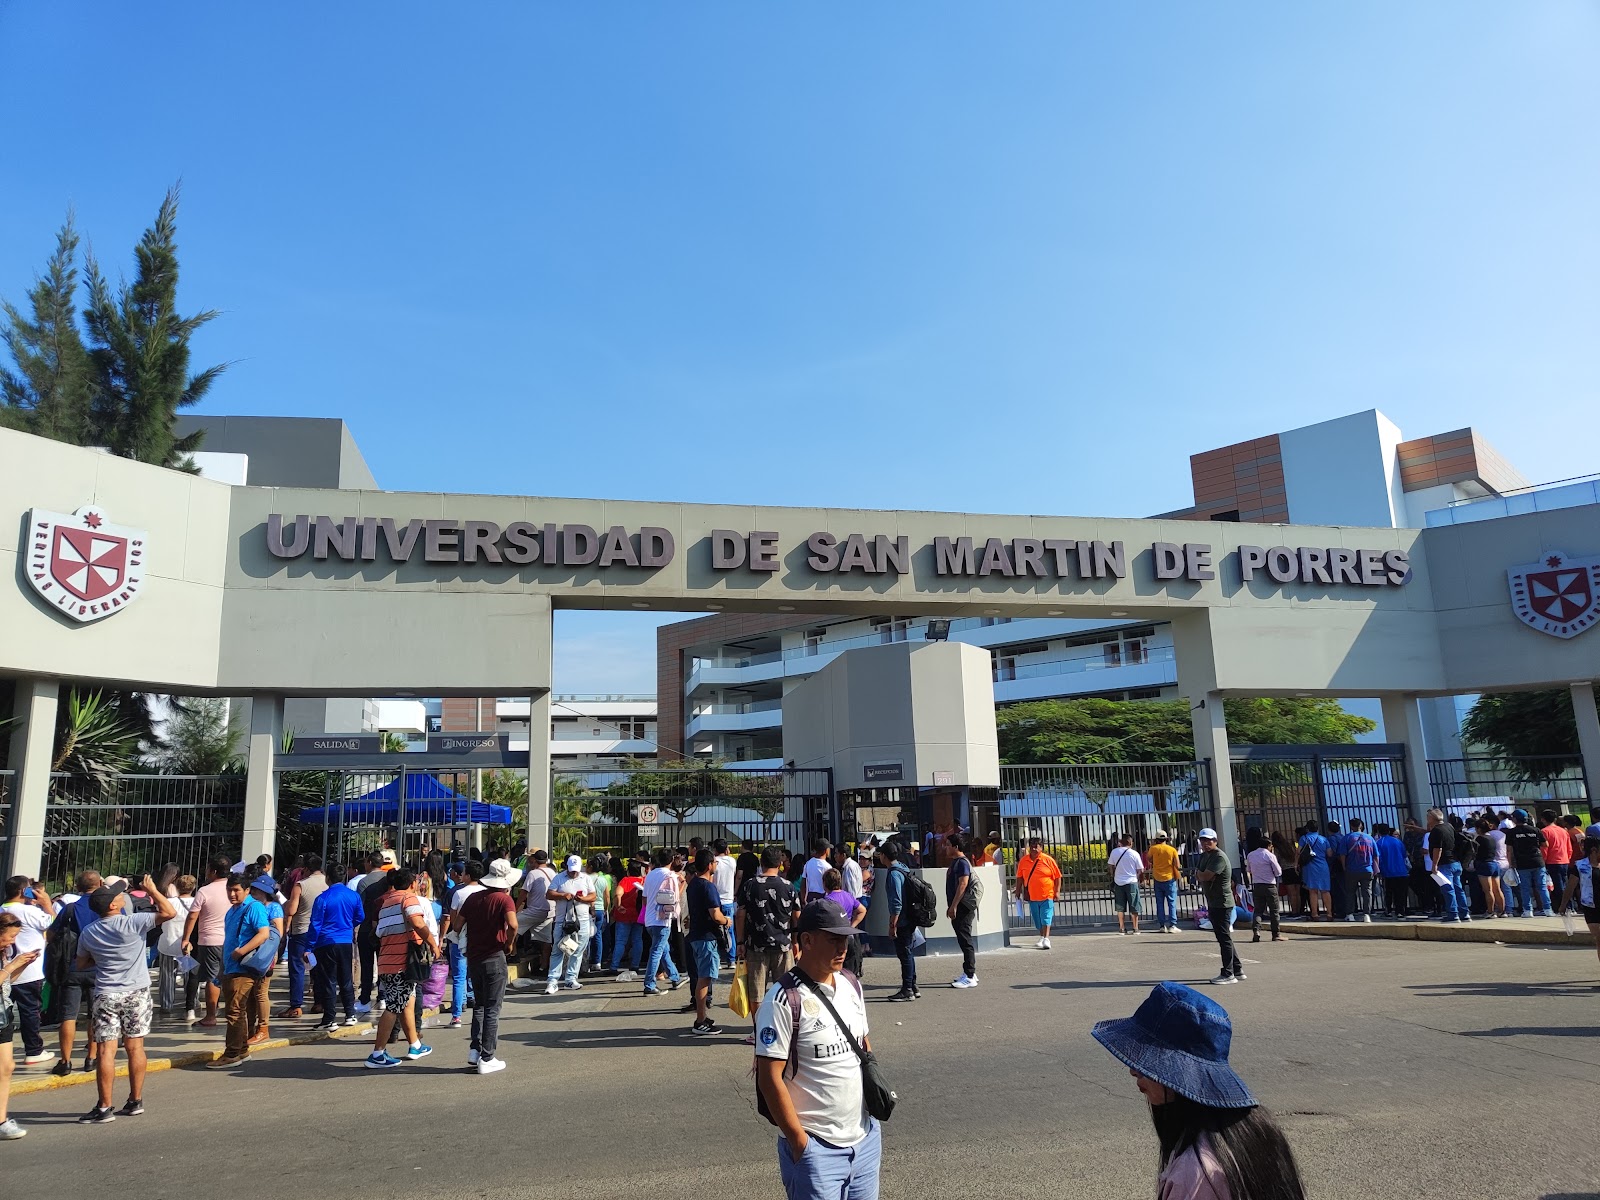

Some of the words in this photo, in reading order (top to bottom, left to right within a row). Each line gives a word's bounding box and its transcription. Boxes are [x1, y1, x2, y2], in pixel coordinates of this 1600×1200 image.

[266, 513, 676, 568] UNIVERSIDAD
[711, 528, 781, 572] DE
[807, 531, 909, 575] SAN
[933, 536, 1127, 579] MARTIN
[1151, 541, 1215, 581] DE
[1238, 544, 1414, 586] PORRES
[313, 740, 349, 750] SALIDA
[452, 739, 495, 749] INGRESO
[643, 810, 654, 818] 15
